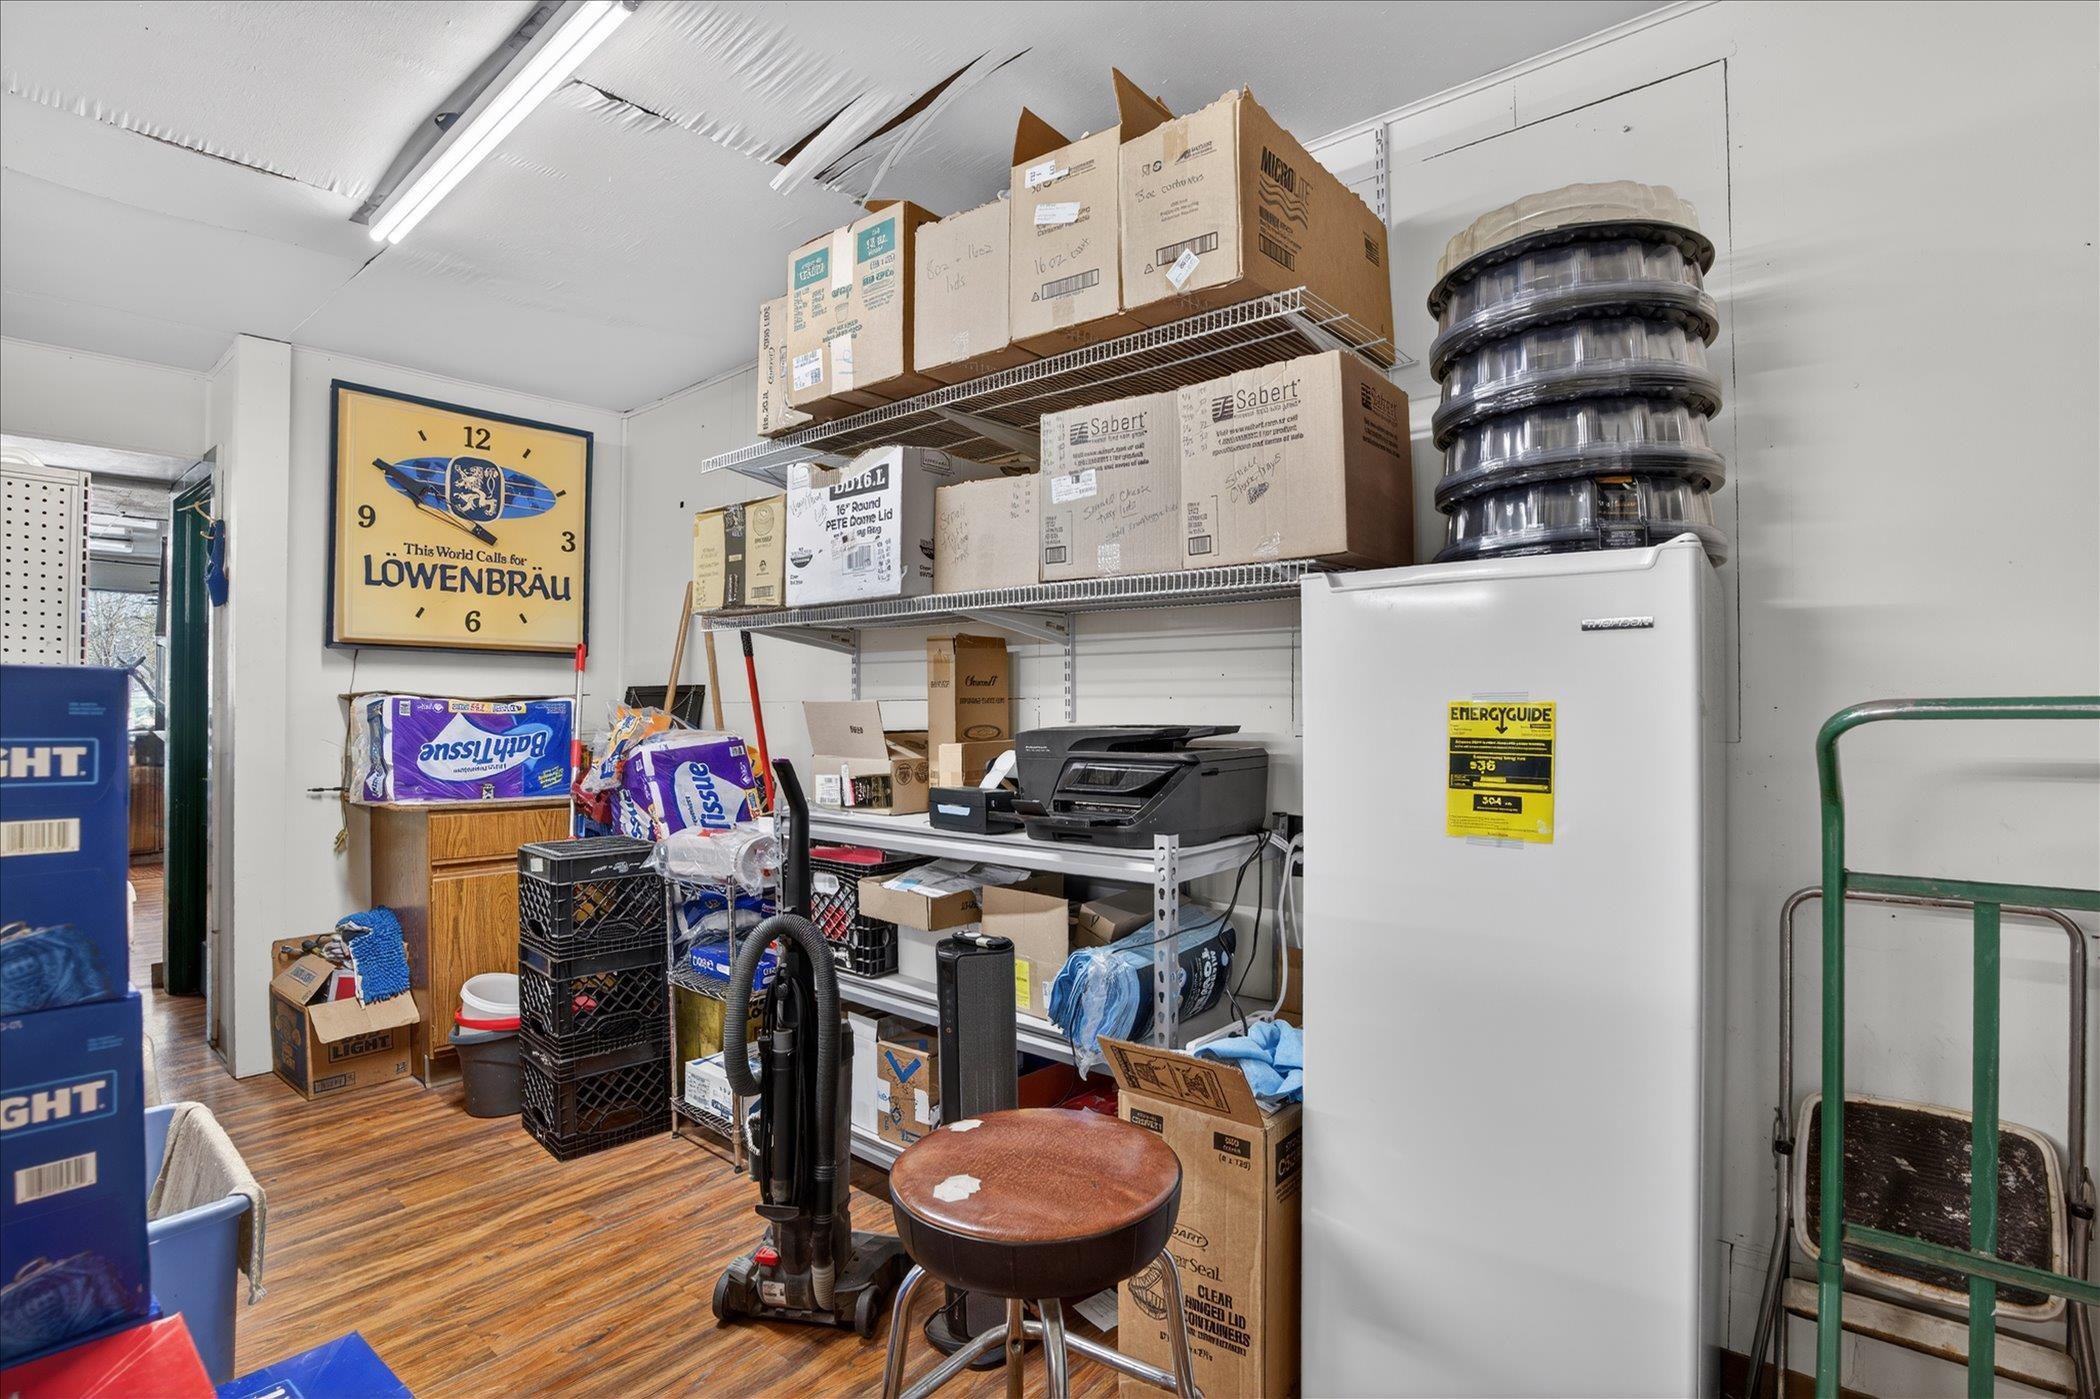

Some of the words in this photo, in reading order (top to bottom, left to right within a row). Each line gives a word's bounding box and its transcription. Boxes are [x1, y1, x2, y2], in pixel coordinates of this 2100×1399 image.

[1237, 380, 1299, 409] Sabert
[1091, 412, 1146, 437] Sabert
[464, 427, 491, 451] 12
[358, 504, 376, 528] 9
[852, 497, 881, 512] Round
[825, 517, 848, 531] PETE
[850, 513, 876, 528] Dome
[878, 508, 893, 521] Lid
[561, 531, 576, 552] 3
[404, 542, 435, 557] This
[436, 546, 473, 561] World
[476, 551, 507, 565] Calls
[509, 554, 527, 566] for
[363, 552, 571, 601] LÖWENBRÄU
[465, 610, 481, 632] 6
[1450, 706, 1552, 722] ENERGYGUIDE
[332, 1034, 391, 1059] LIGHT
[1172, 1227, 1203, 1244] DART
[1197, 1284, 1233, 1310] CLEAR
[1185, 1295, 1225, 1322] HINGED
[1228, 1311, 1246, 1330] LID
[1184, 1310, 1251, 1347] CONTAINERS
